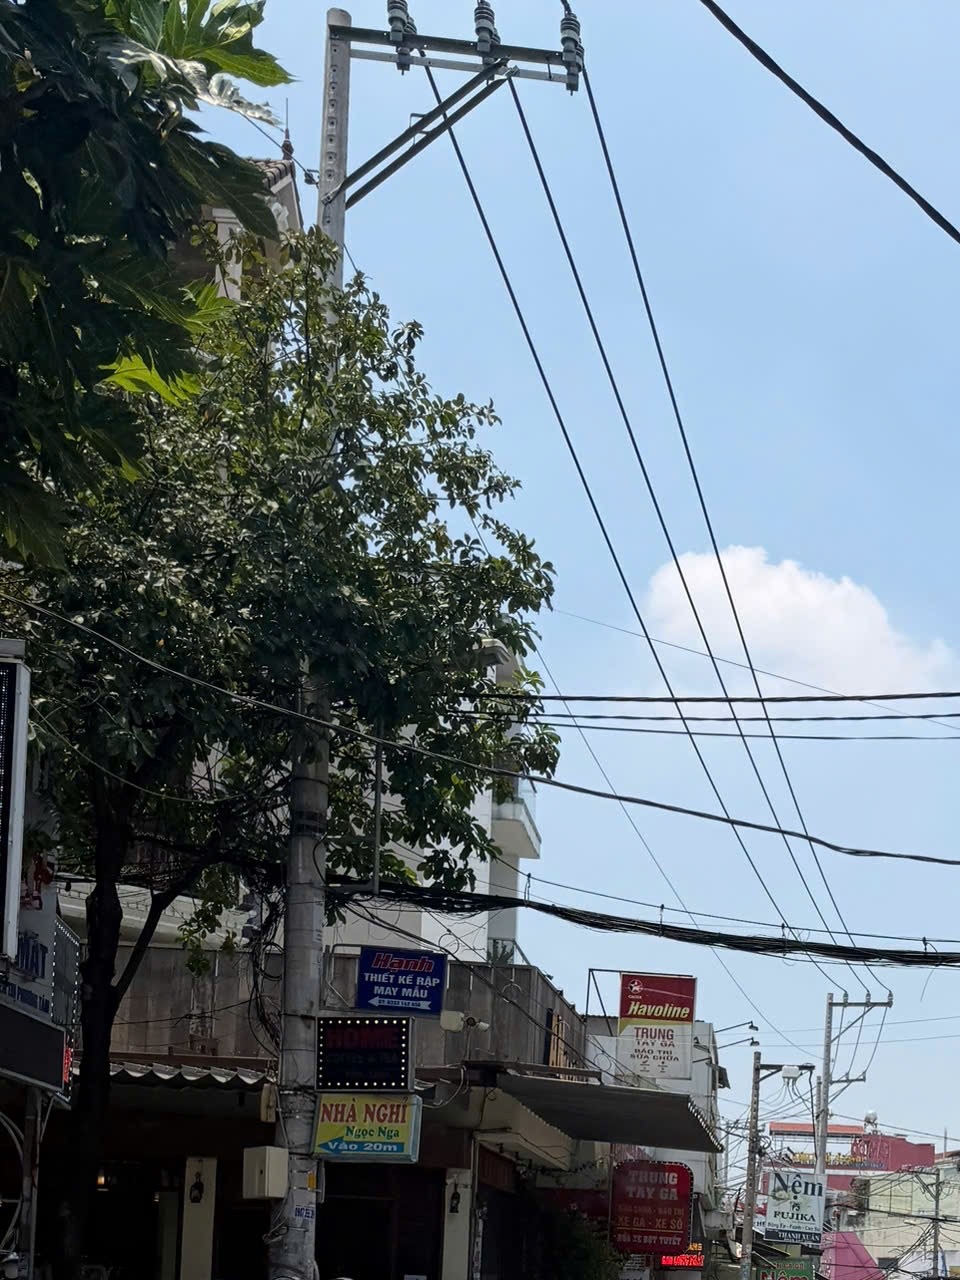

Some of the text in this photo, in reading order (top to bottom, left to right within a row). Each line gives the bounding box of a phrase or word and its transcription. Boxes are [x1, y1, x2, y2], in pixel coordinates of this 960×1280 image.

[371, 952, 435, 973] Hạnh
[363, 971, 441, 988] THIẾT KẾ RẬP
[373, 985, 399, 996] MAY
[626, 1000, 690, 1019] Havoline
[634, 1027, 674, 1040] TRUNG
[321, 1096, 408, 1123] NHÀ NGHỈ
[346, 1126, 400, 1140] Ngọc Nga
[363, 1142, 398, 1152] 20m
[628, 1170, 678, 1185] TRUNG
[625, 1186, 678, 1200] TAY GA
[772, 1172, 823, 1200] Nệm
[774, 1211, 816, 1222] FUJIKA
